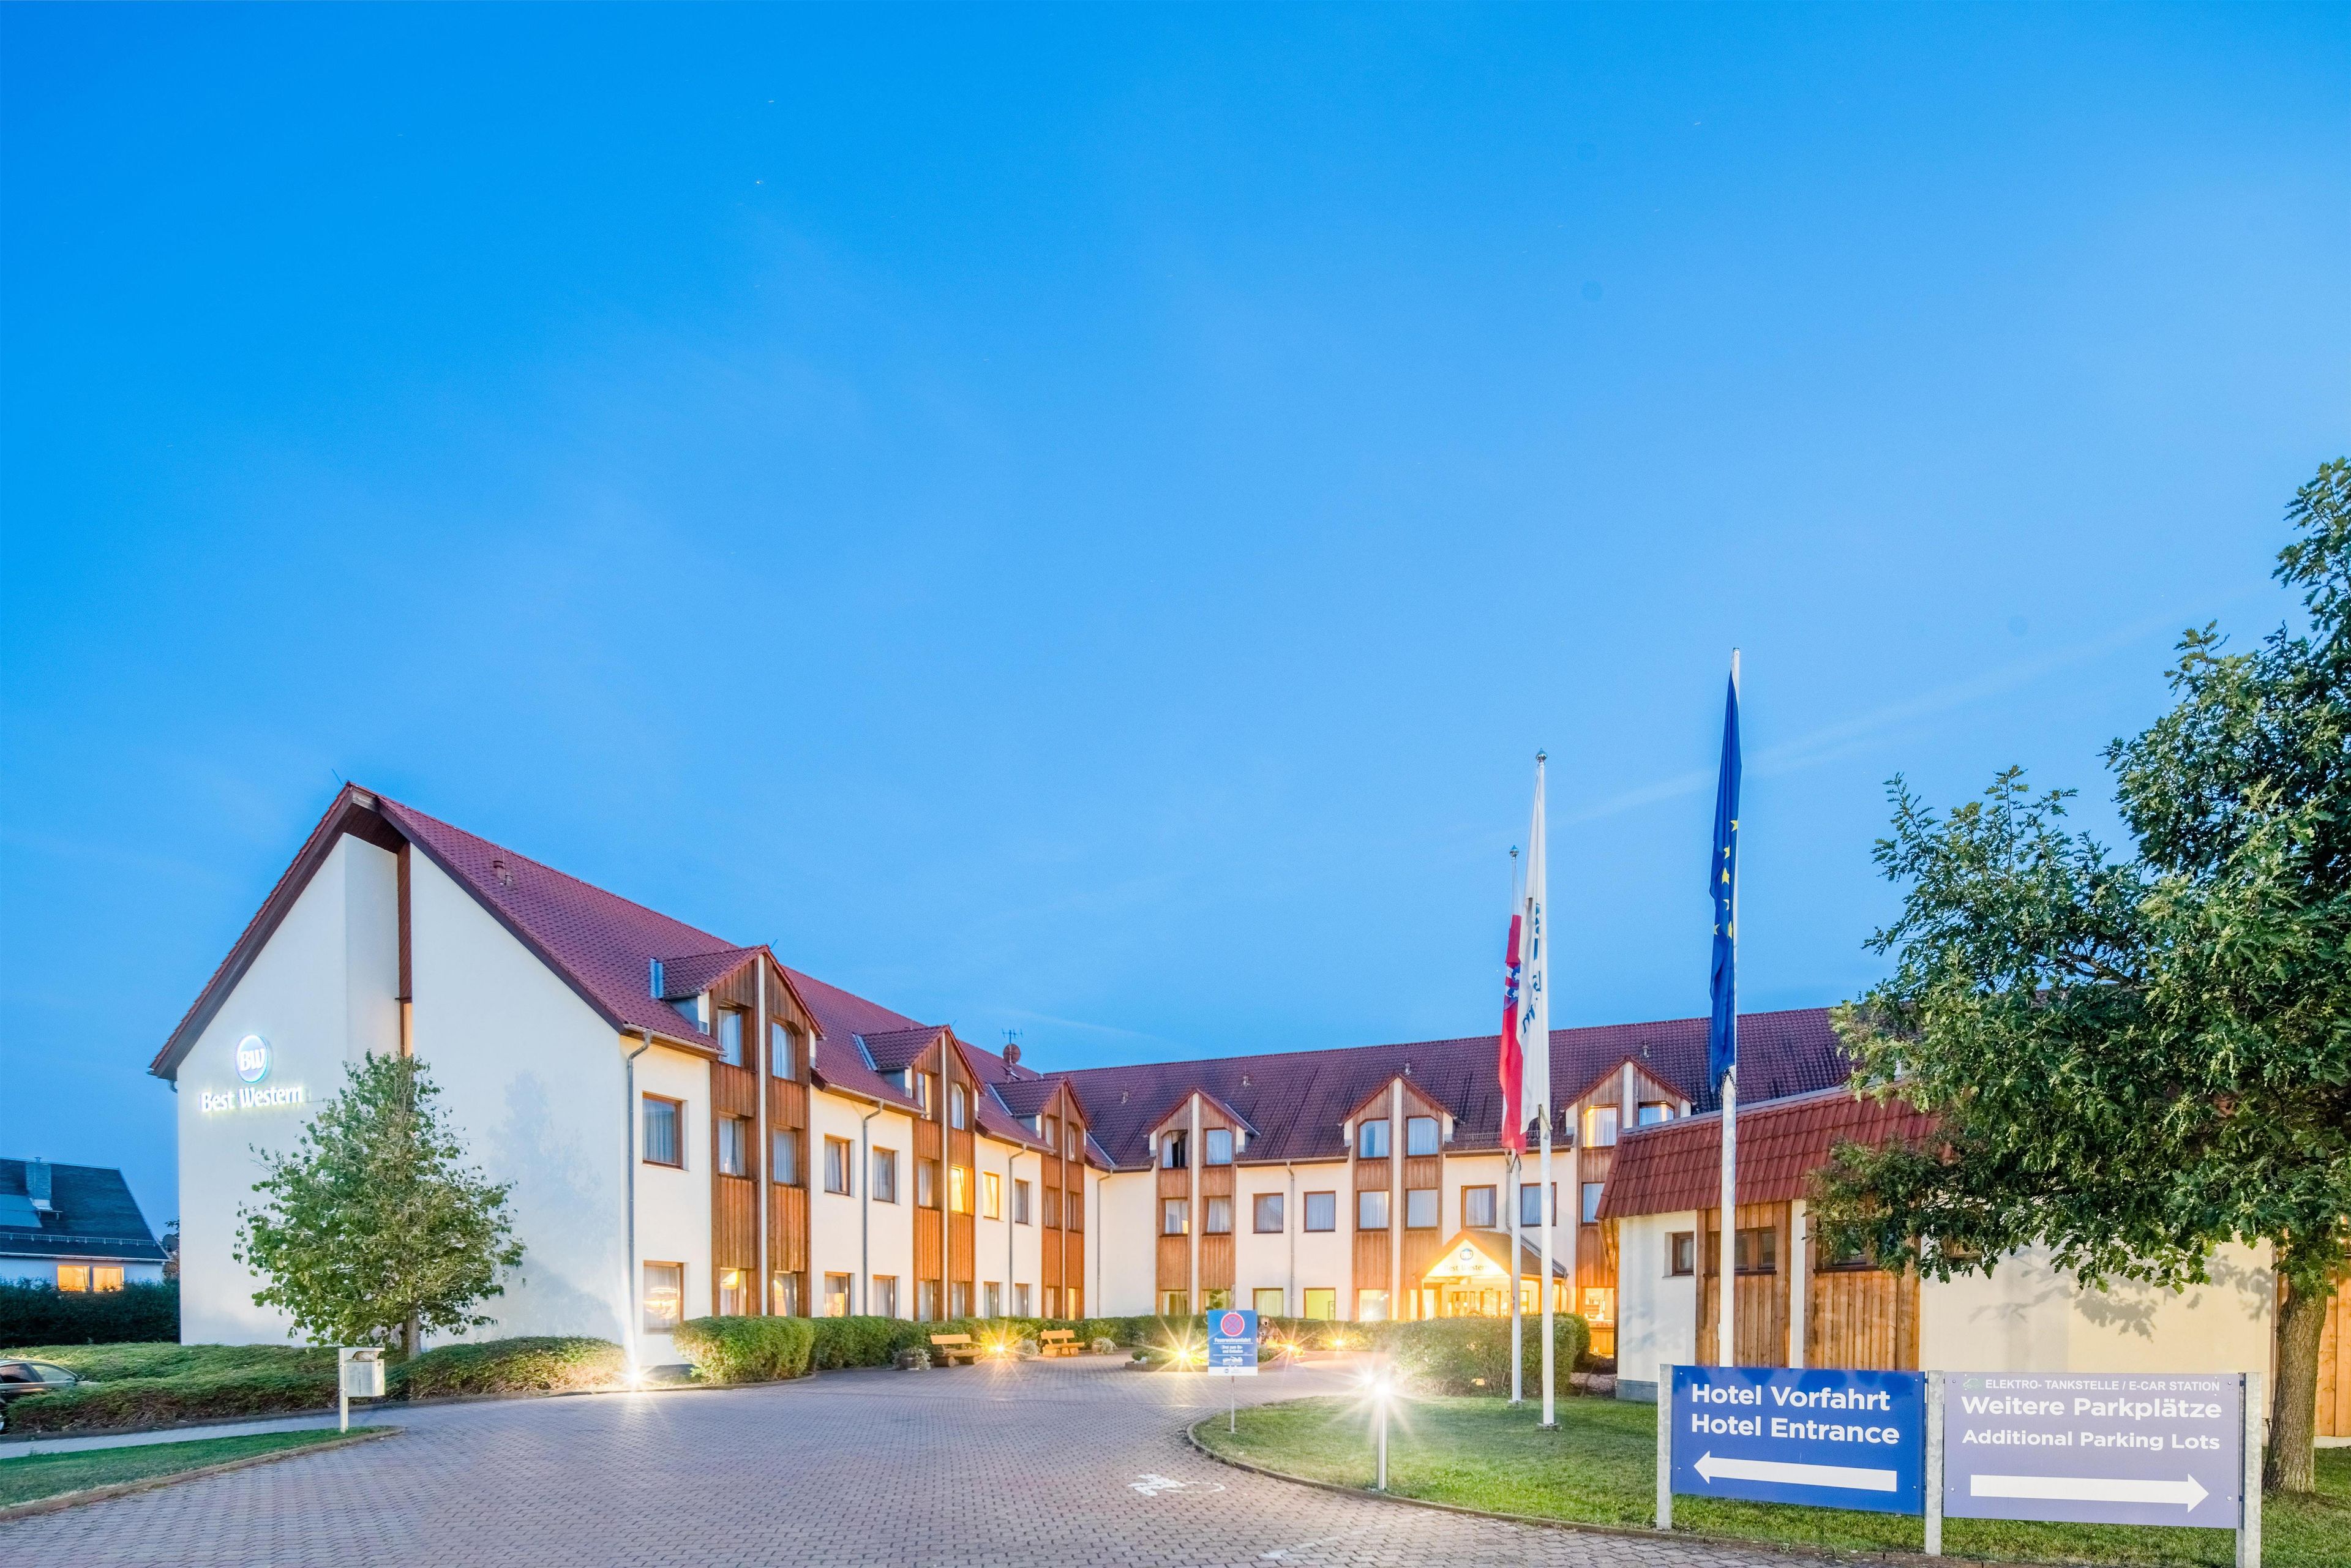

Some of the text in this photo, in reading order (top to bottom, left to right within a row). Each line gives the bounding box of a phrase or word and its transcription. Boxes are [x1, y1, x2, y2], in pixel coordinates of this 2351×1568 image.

[239, 1048, 266, 1071] BW
[201, 1087, 302, 1112] Best Western
[1692, 1383, 1891, 1411] Hotel Vorfahrt
[1985, 1379, 2219, 1391] ELEKTRO- TANKSTELLE / E-CAR STATION
[1961, 1396, 2222, 1420] Weitere Parkplätze
[1692, 1413, 1900, 1444] Hotel Entrance
[1962, 1429, 2220, 1451] Additional Parking Lots
